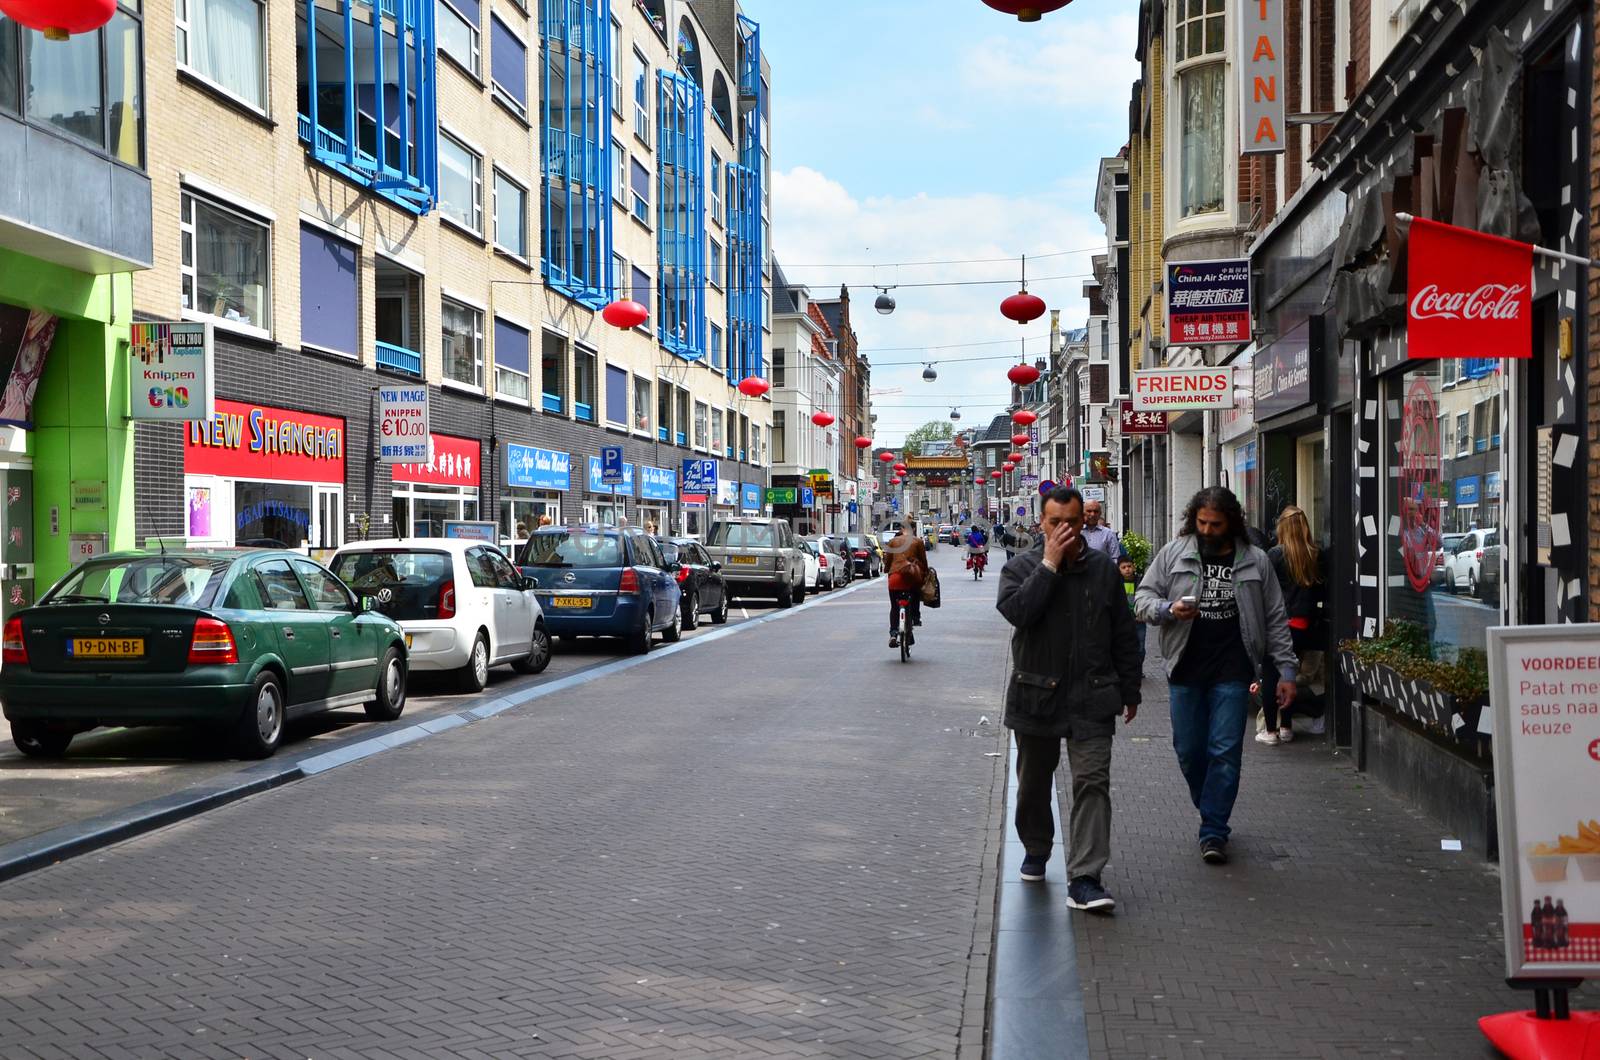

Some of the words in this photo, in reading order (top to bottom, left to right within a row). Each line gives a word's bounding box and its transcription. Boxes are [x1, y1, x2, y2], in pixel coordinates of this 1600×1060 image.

[1178, 274, 1202, 283] China
[1203, 273, 1217, 282] Air
[1218, 272, 1248, 281] Service
[1410, 284, 1527, 320] Coca-Cola
[1174, 315, 1198, 323] CHEAP
[1215, 313, 1246, 321] TICKETS
[187, 333, 202, 345] ZHOU
[144, 370, 195, 381] Knippen
[1136, 374, 1227, 393] FRIENDS
[148, 386, 190, 408] €10
[381, 391, 398, 402] NEW
[400, 391, 425, 402] IMAGE
[1142, 395, 1223, 405] SUPERMARKET
[385, 409, 422, 417] KNIPPEN
[190, 411, 244, 449] NEW
[605, 450, 618, 466] P
[704, 462, 713, 475] P
[80, 544, 93, 554] 58
[78, 640, 140, 654] 19-DN-BF
[1520, 681, 1564, 696] Patat
[1521, 703, 1561, 716] saus
[1522, 720, 1572, 735] keuze
